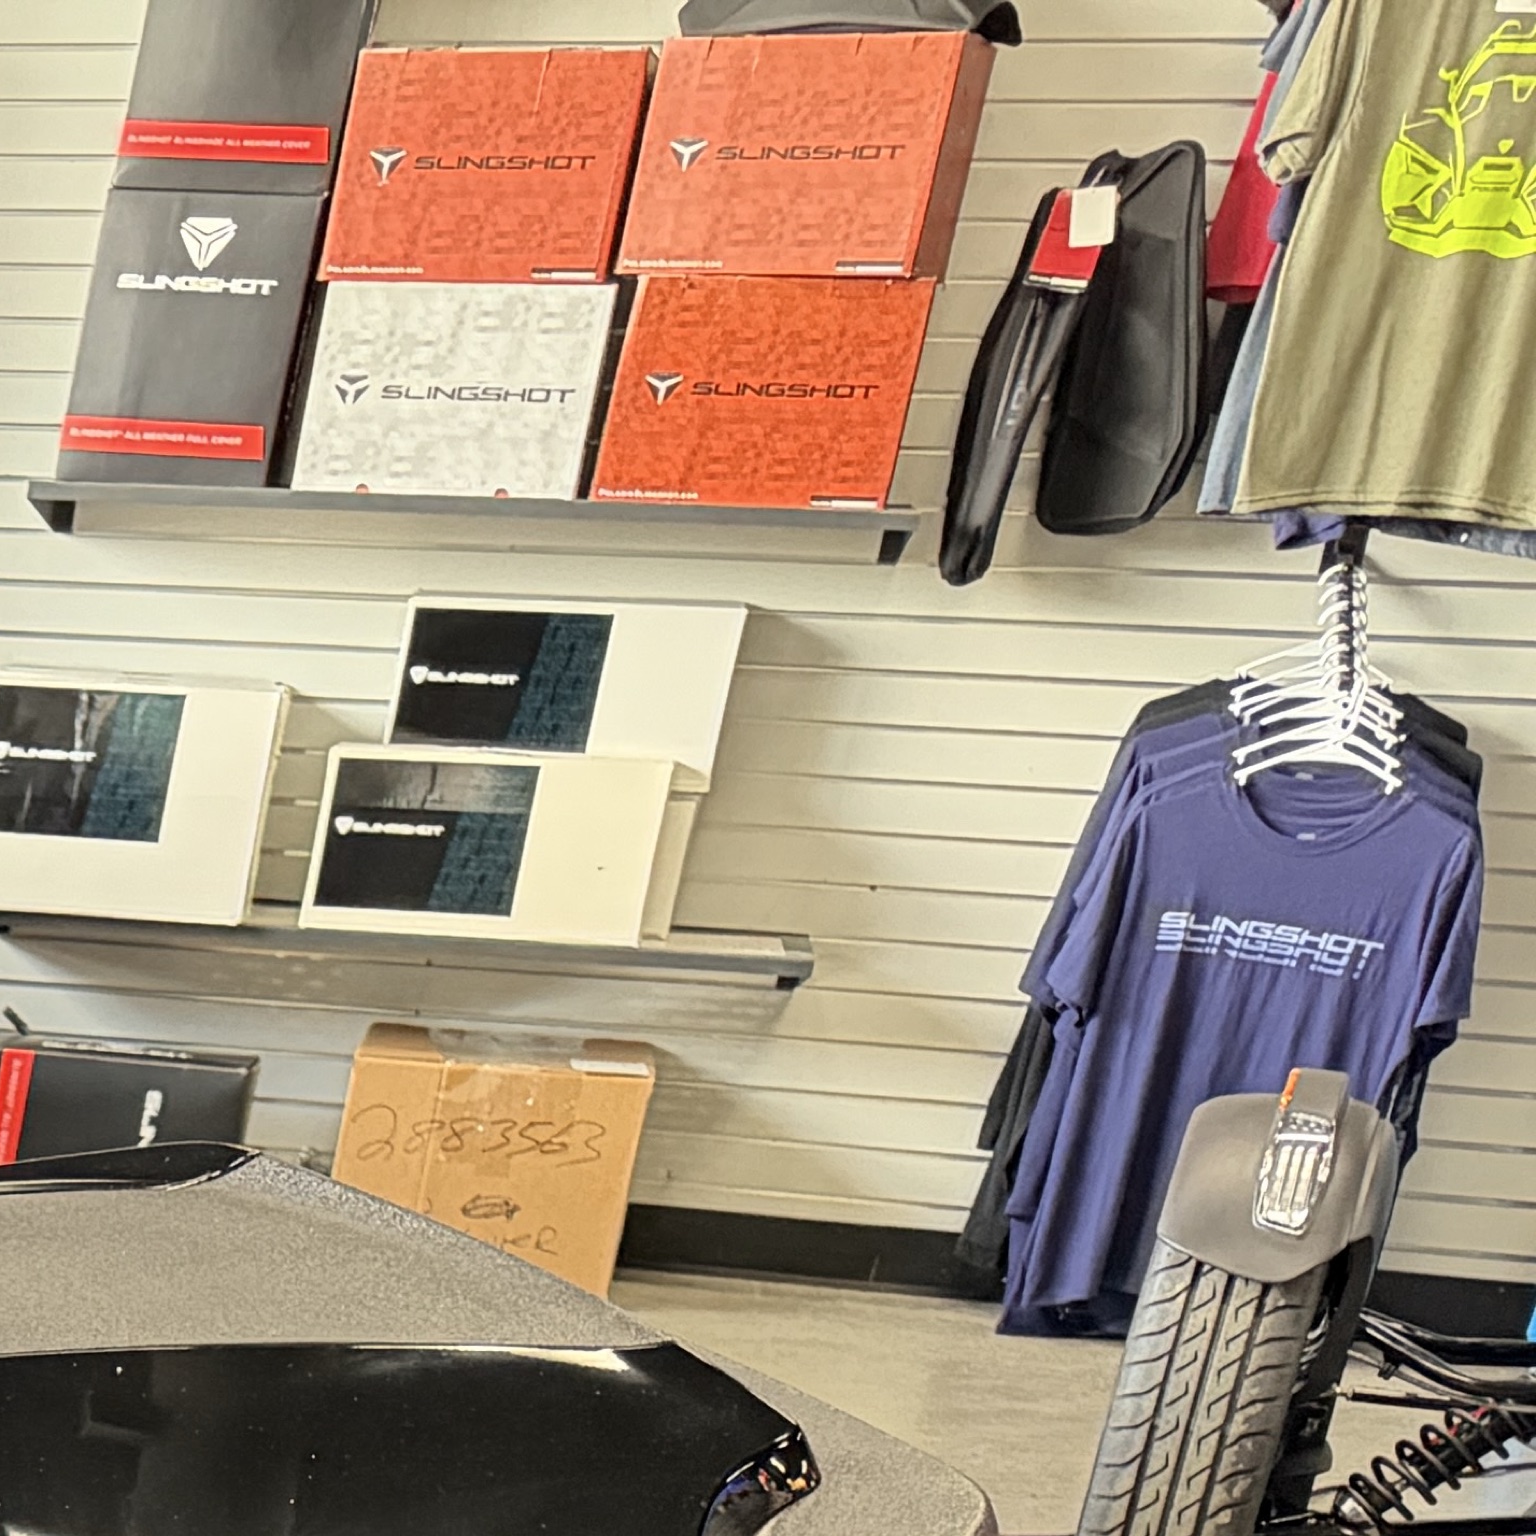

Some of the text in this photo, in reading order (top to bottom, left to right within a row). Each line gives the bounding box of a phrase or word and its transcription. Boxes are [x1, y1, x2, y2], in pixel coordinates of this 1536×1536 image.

[711, 144, 906, 160] SLINGSHOT
[414, 155, 595, 170] SLINGSHOT
[116, 272, 279, 296] SLINGSHOT
[380, 384, 576, 404] SLINGSHOT
[690, 381, 879, 400] SLINGSHOT
[1155, 911, 1385, 981] SLINGSHOT
[351, 1104, 607, 1169] 2883563
